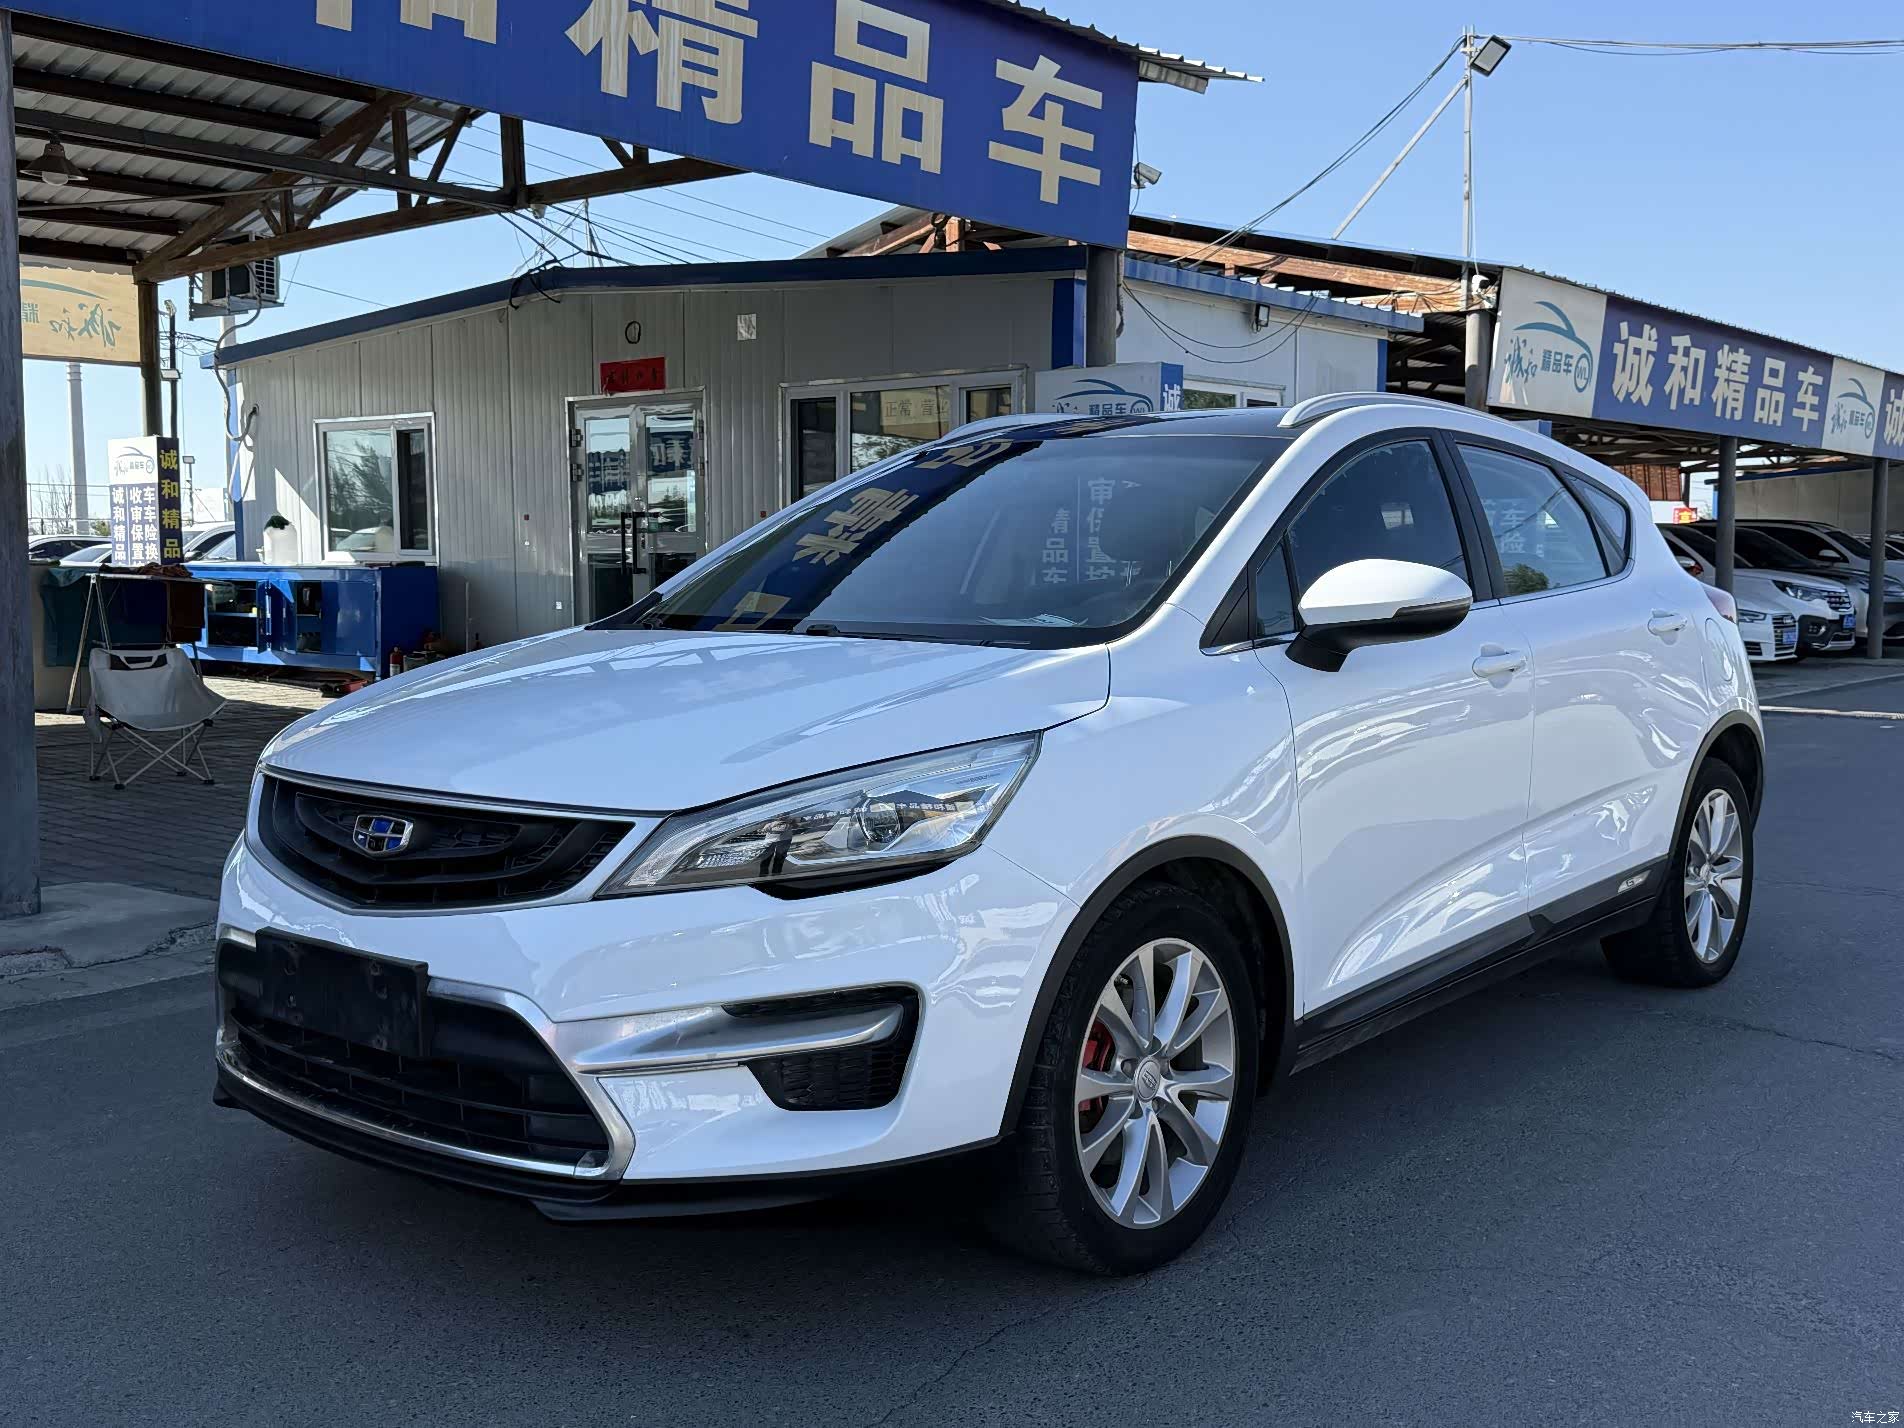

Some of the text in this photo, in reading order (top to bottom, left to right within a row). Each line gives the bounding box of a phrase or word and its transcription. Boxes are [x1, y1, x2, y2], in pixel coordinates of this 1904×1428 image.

[1541, 348, 1574, 376] 精品车
[1612, 321, 1824, 432] 诚和精品车
[112, 486, 127, 566] 诚和精品
[160, 449, 181, 559] 诚和精品
